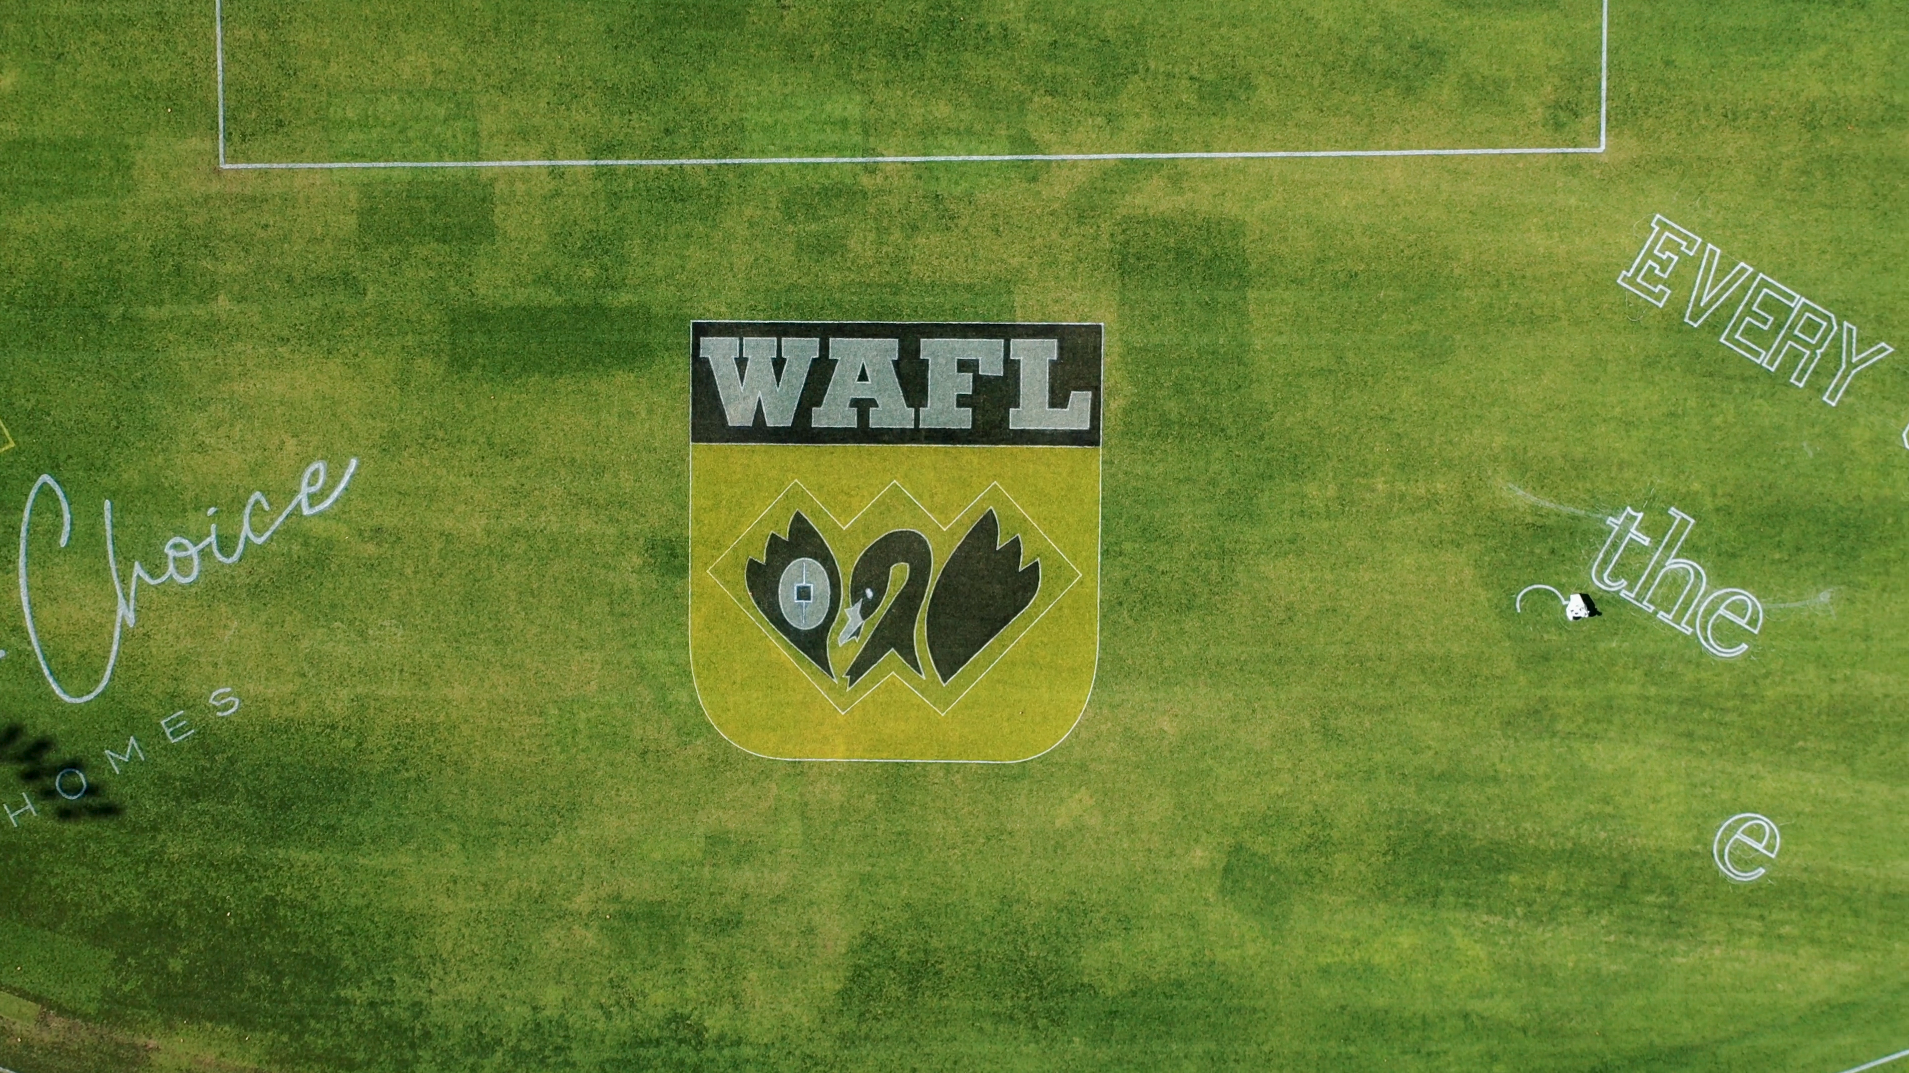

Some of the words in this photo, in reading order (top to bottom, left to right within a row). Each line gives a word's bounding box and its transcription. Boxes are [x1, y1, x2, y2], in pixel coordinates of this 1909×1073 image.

[700, 336, 1092, 430] WAFL
[1616, 214, 1895, 407] EVERY
[18, 457, 359, 703] Choice
[1590, 506, 1763, 657] the
[3, 687, 241, 827] HOMES
[1712, 812, 1781, 882] e
